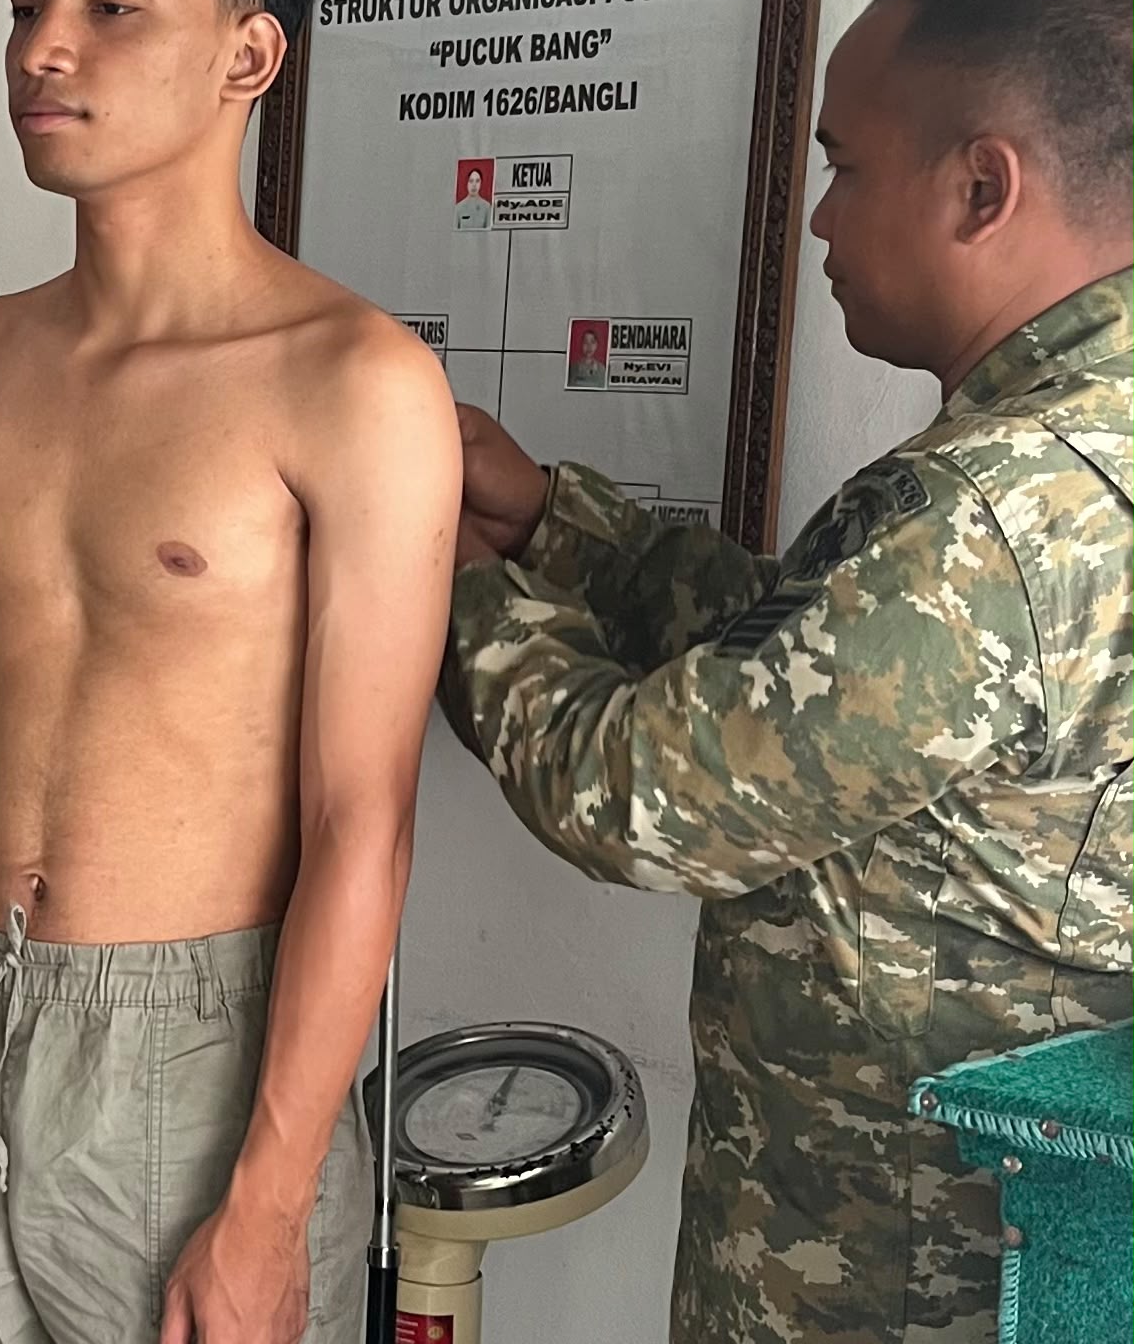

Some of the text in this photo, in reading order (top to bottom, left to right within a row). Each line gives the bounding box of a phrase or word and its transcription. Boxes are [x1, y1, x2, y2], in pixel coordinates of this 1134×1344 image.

[429, 28, 612, 68] “PUCUK BANG”
[399, 80, 638, 121] KODIM 1626/BANGLI
[511, 162, 552, 188] KETUA
[496, 199, 564, 210] Ny.ADE
[498, 212, 561, 222] RINUN
[402, 320, 445, 345] TARIS
[610, 324, 687, 351] BENDAHARA
[623, 362, 672, 373] Ny.EVI
[610, 375, 682, 386] BIRAWAN
